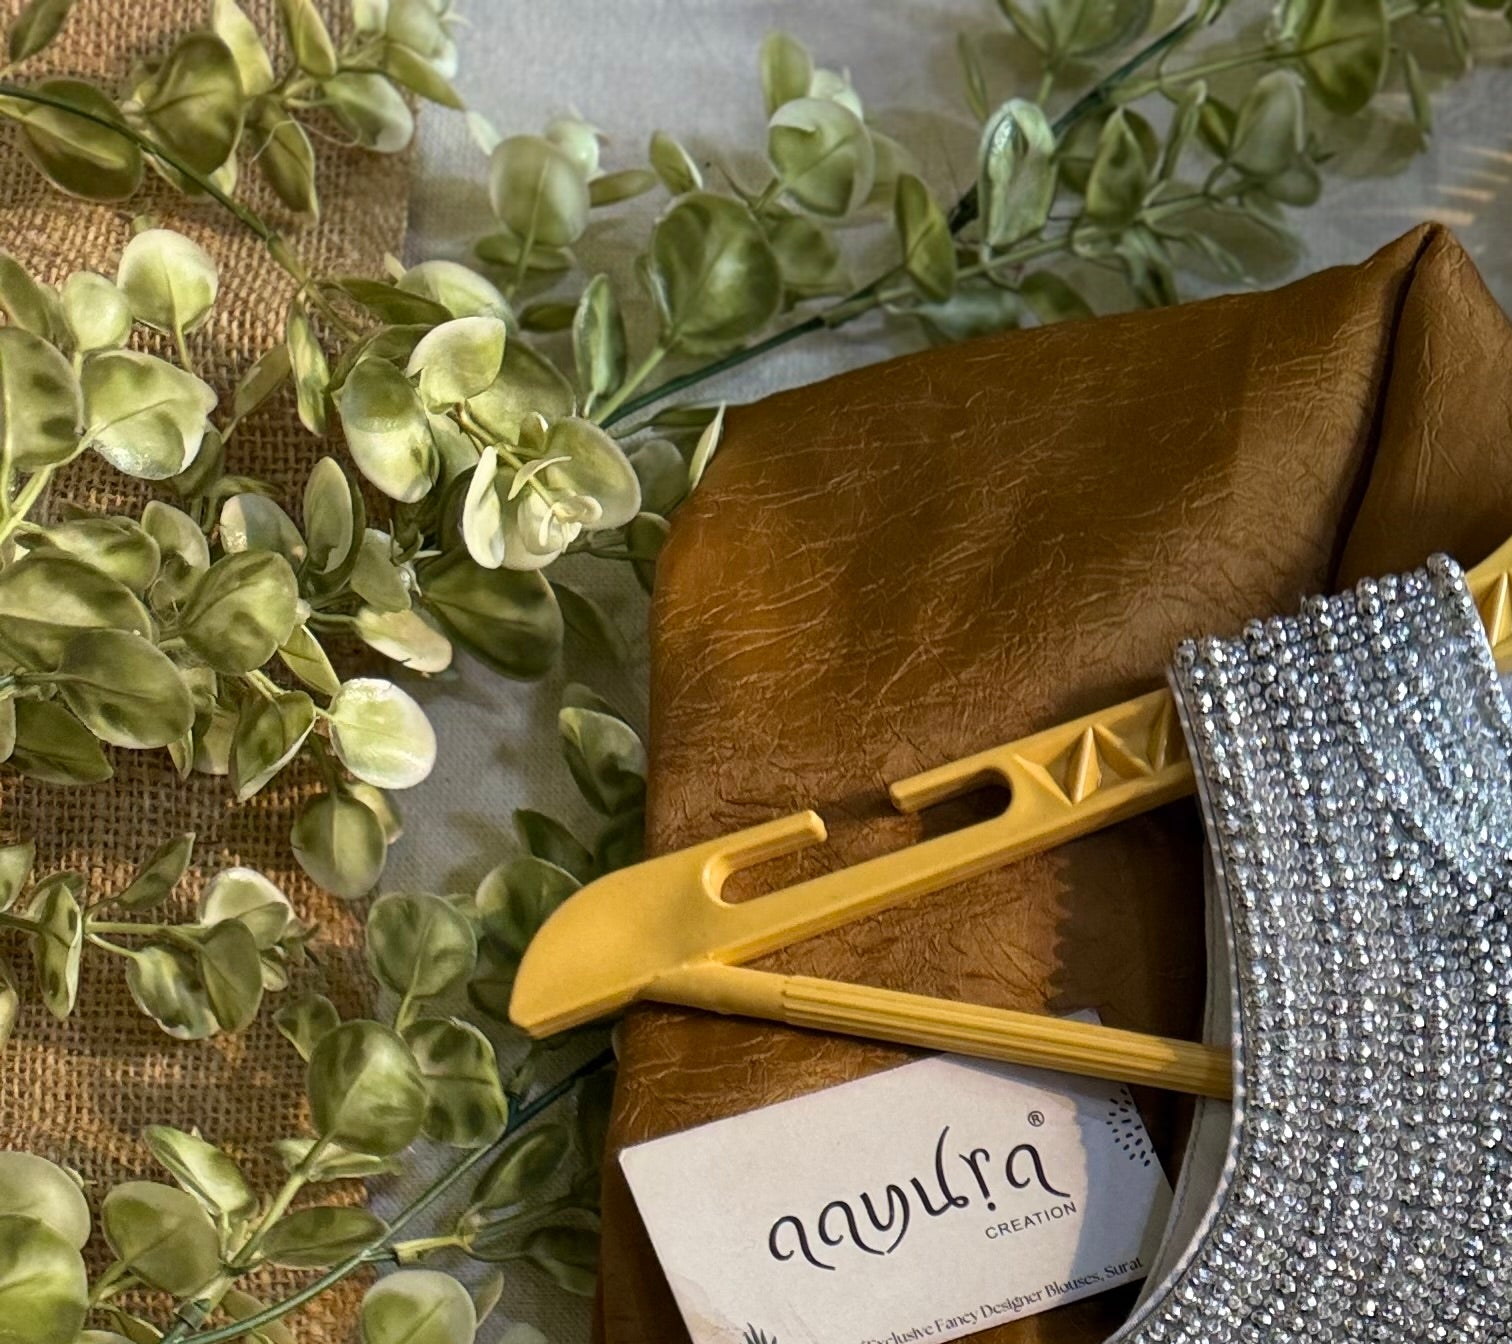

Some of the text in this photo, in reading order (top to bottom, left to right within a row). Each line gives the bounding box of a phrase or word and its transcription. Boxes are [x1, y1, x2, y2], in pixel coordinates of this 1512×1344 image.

[985, 1201, 1078, 1240] CREATION
[934, 1310, 979, 1334] Fancy
[980, 1289, 1043, 1318] Designer
[1044, 1271, 1104, 1298] Blouses,
[1104, 1257, 1144, 1279] Surat
